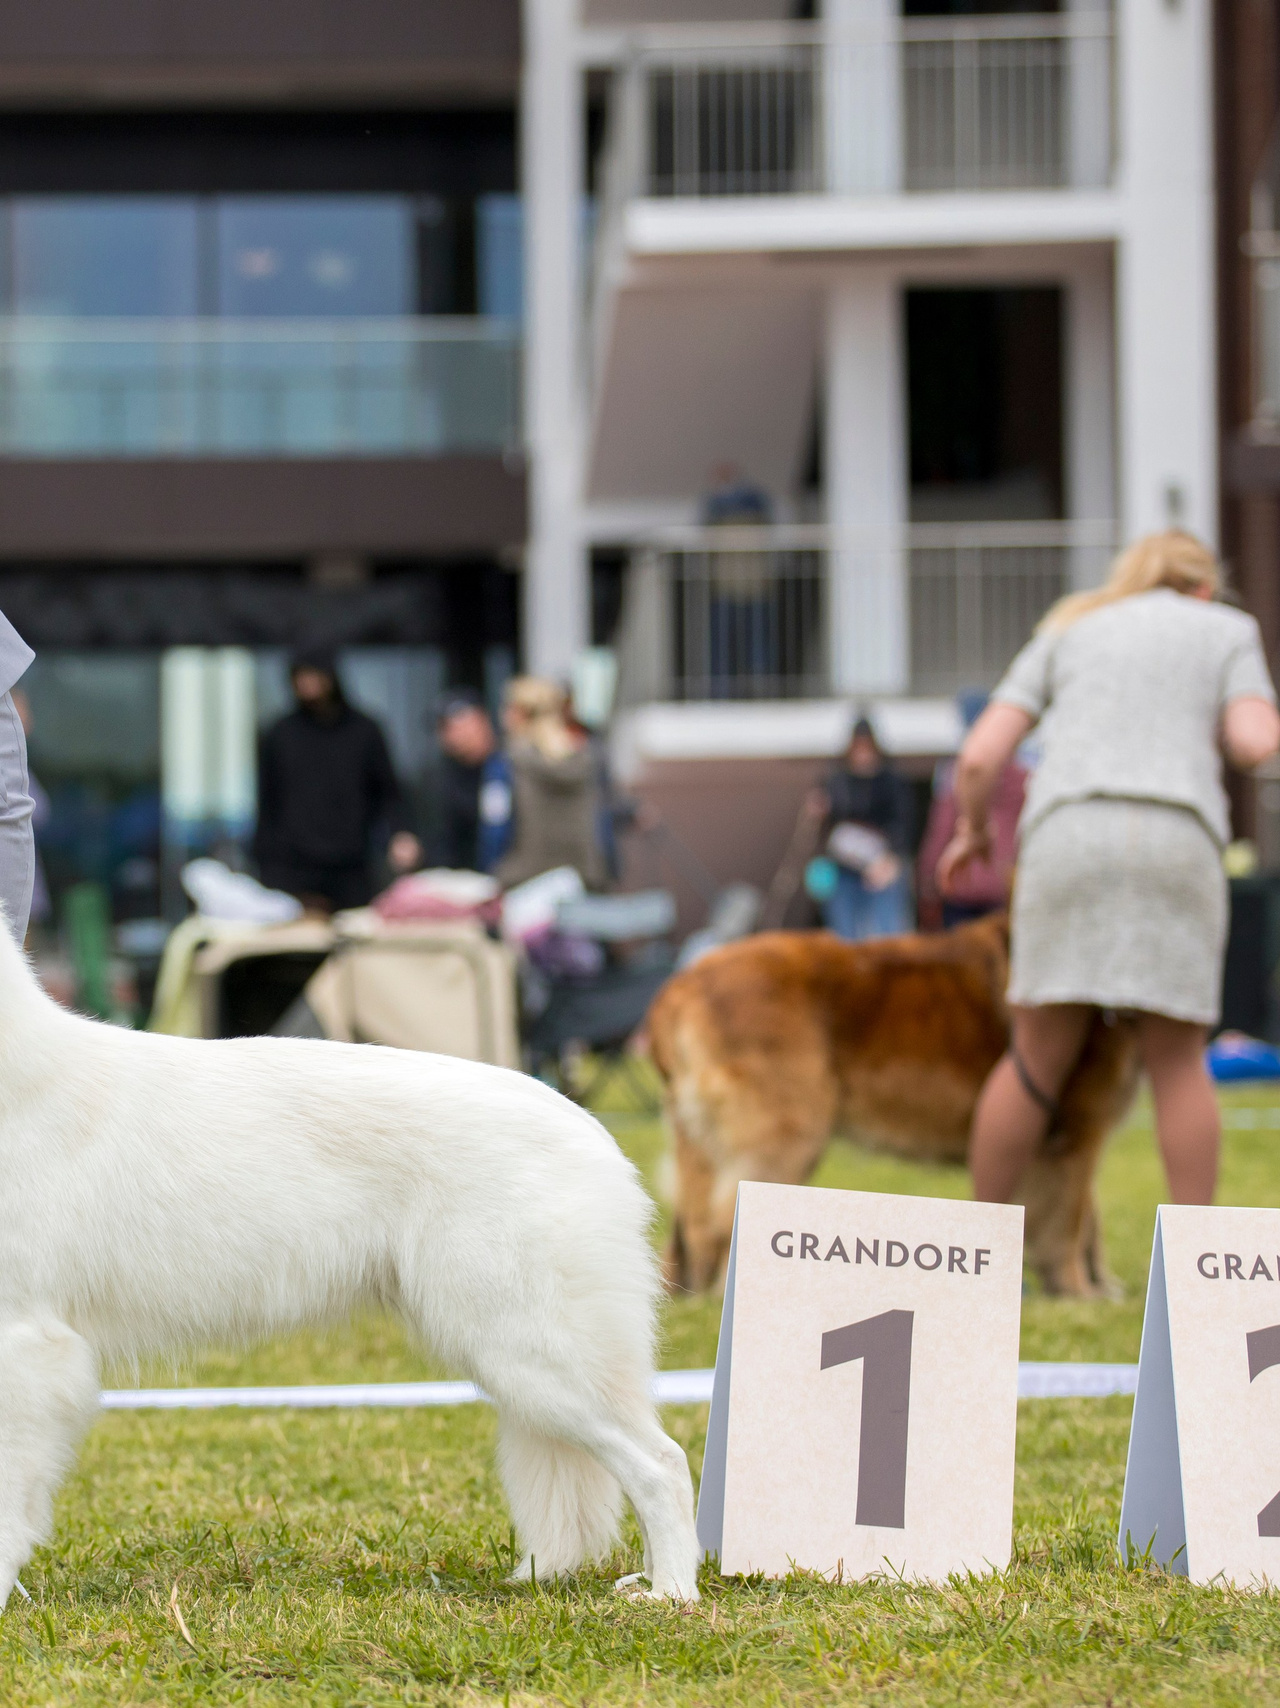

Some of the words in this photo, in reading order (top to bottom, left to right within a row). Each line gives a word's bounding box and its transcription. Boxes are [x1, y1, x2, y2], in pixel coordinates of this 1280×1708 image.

[771, 1230, 991, 1275] GRANDORF
[1197, 1252, 1280, 1281] GRA
[820, 1308, 914, 1529] 1
